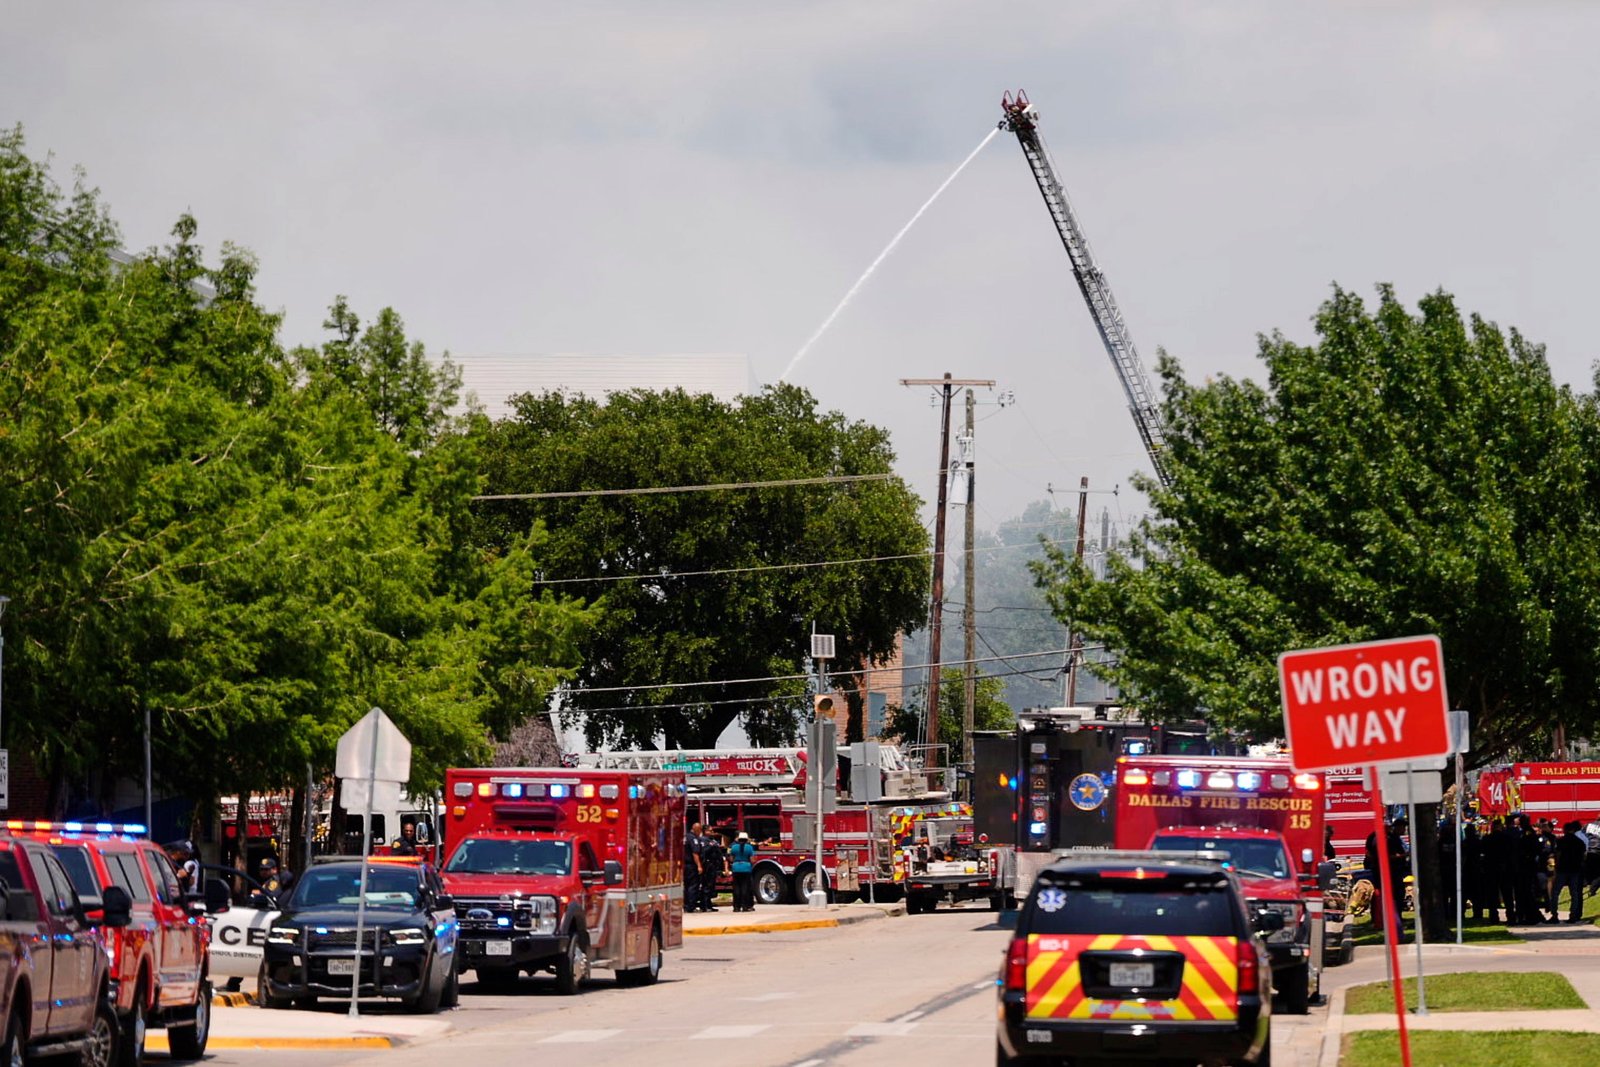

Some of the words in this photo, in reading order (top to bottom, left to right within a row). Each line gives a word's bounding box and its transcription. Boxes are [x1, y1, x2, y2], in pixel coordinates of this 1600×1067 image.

[1290, 656, 1434, 705] WRONG
[1325, 707, 1406, 749] WAY
[736, 759, 780, 772] TRUCK
[1326, 765, 1357, 775] SCUE
[1541, 767, 1578, 775] DALLAS
[1128, 793, 1192, 808] DALLAS
[1199, 796, 1240, 810] FIRE
[1246, 797, 1313, 811] RESCUE
[1488, 782, 1504, 805] 14
[576, 805, 602, 823] 52
[1289, 814, 1312, 829] 15
